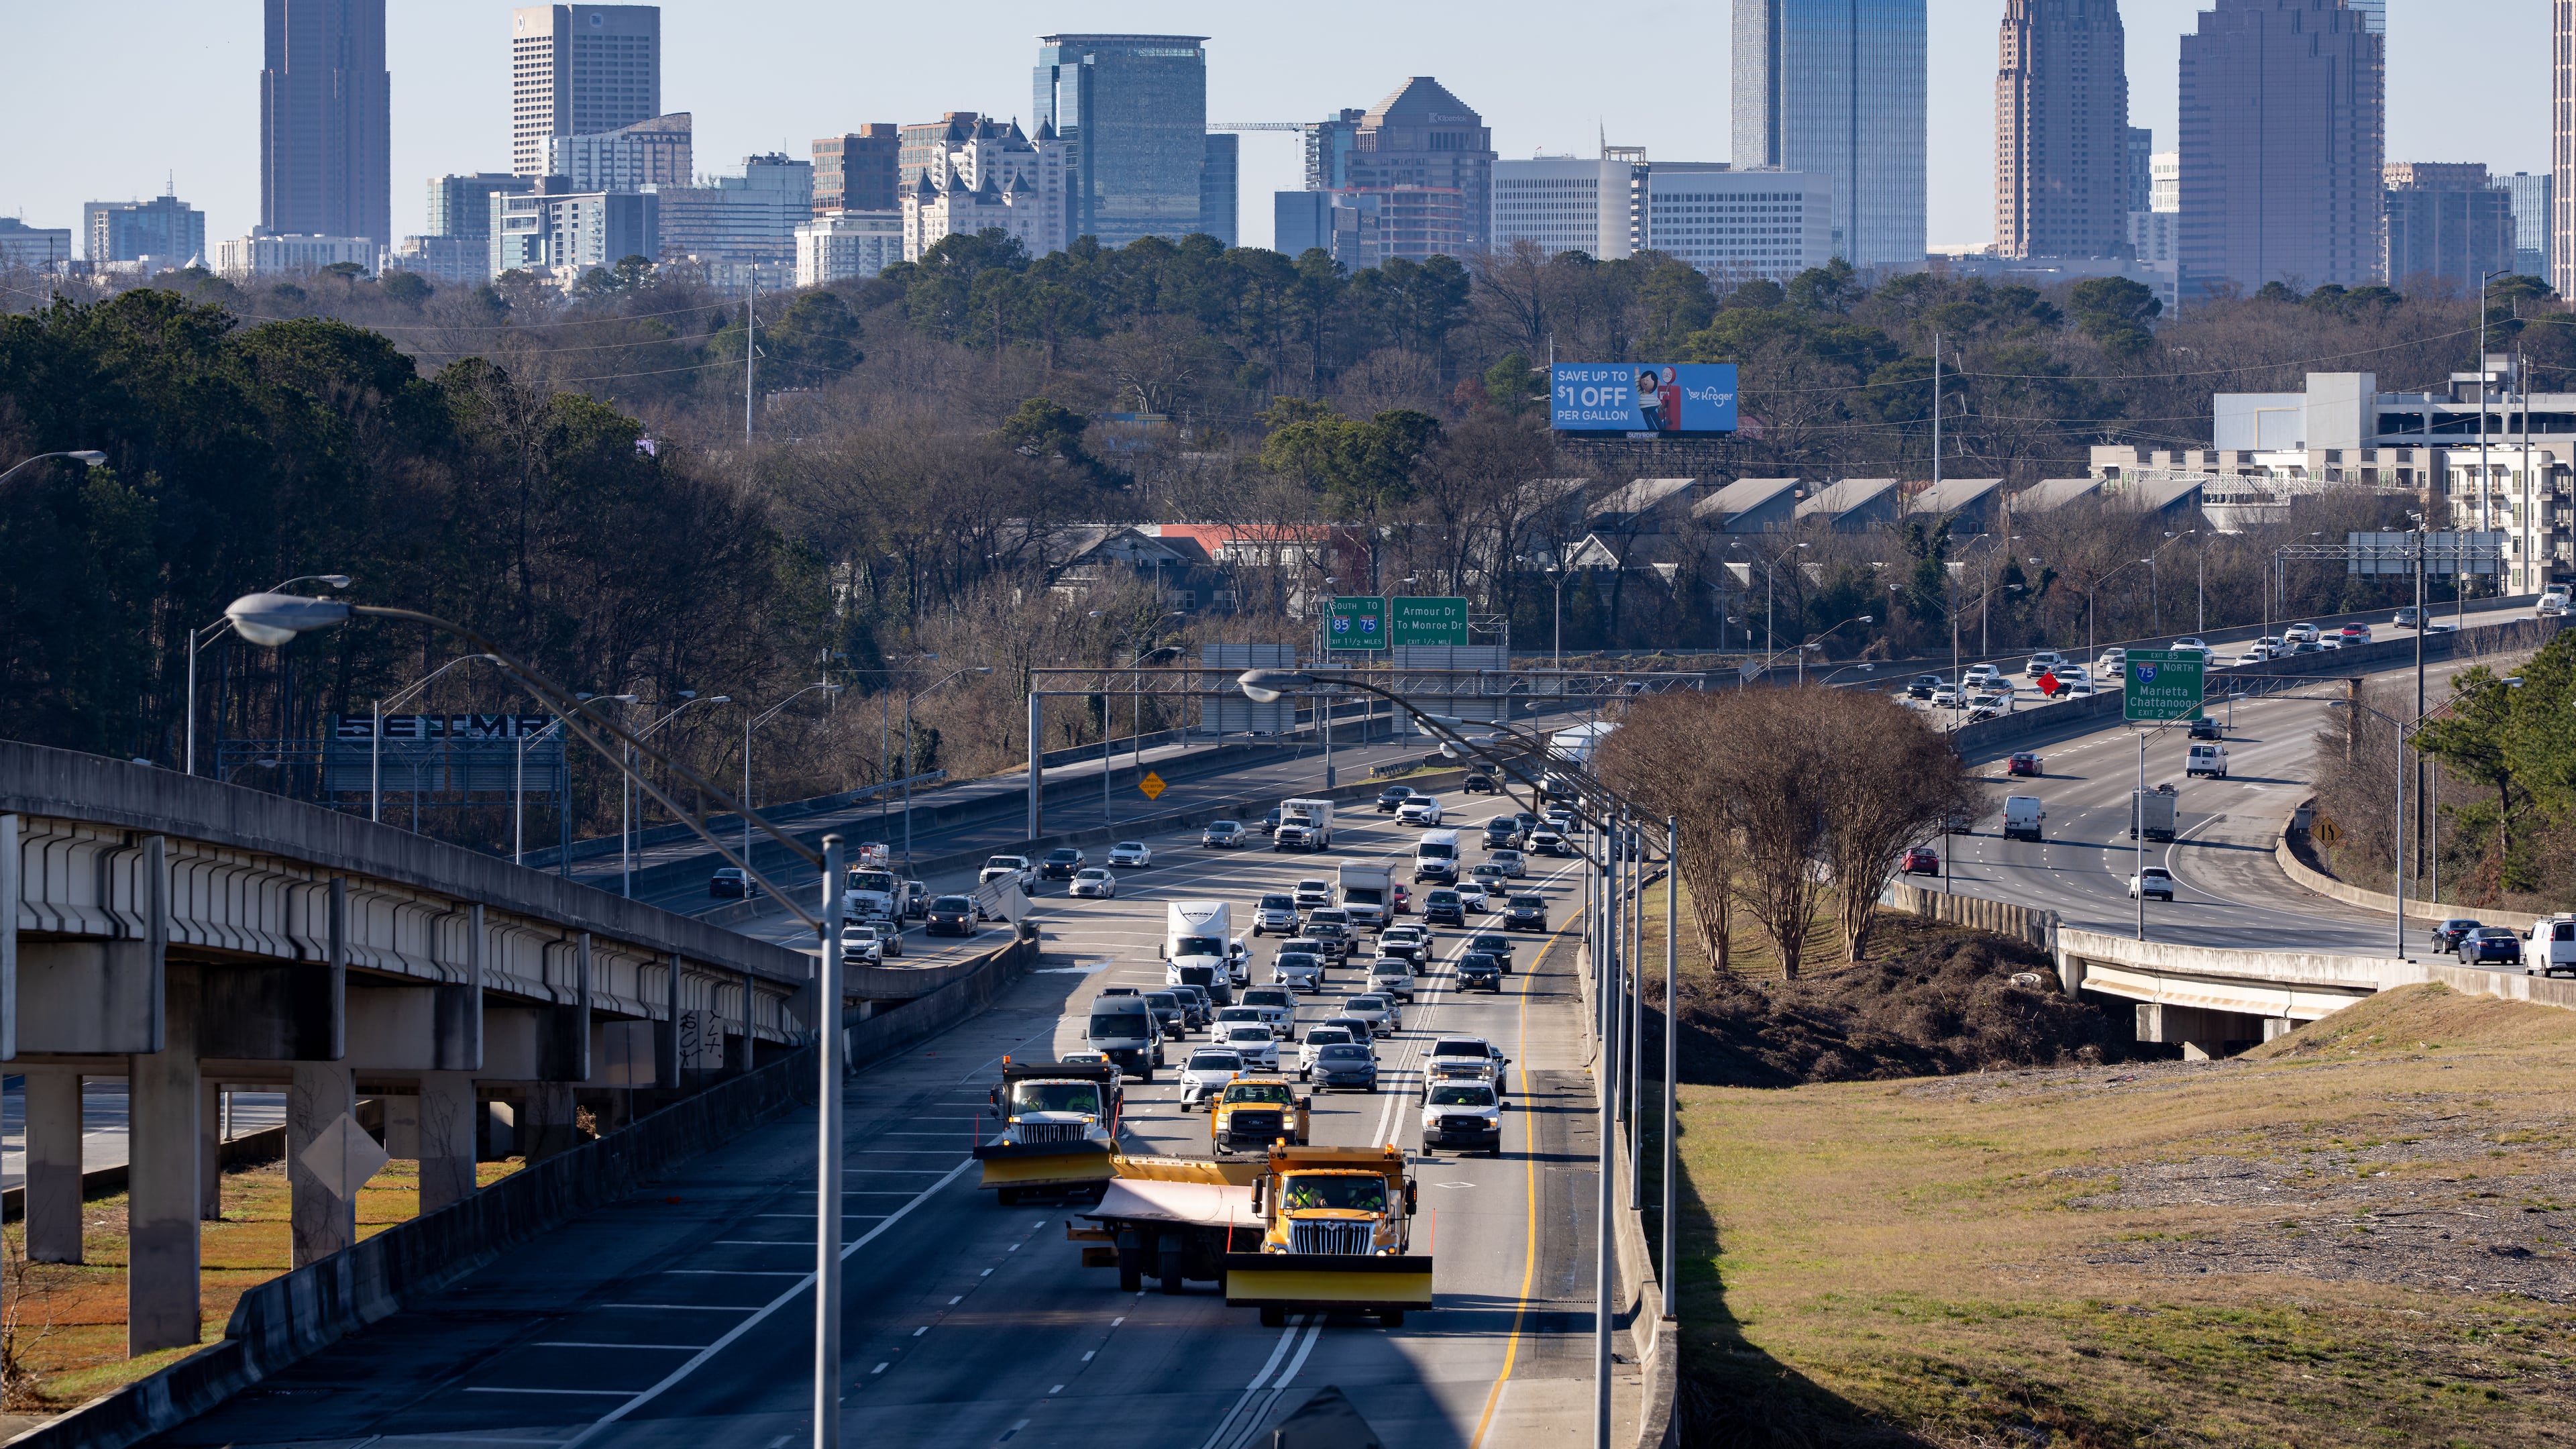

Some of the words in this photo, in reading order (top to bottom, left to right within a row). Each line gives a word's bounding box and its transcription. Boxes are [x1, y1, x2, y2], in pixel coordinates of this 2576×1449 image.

[1438, 115, 1466, 123] Kilpatrick
[1558, 370, 1589, 382] SAVE
[1592, 370, 1608, 382] UP
[1611, 370, 1628, 382] TO
[1557, 385, 1574, 407] $1
[1580, 386, 1628, 407] OFF
[1701, 386, 1733, 407] Kroger
[1558, 411, 1579, 421] PER
[1332, 602, 1357, 610] SOUTH
[1366, 602, 1378, 610] TO
[1403, 606, 1440, 616] Armour
[1444, 606, 1456, 616] Dr
[1334, 619, 1348, 630] 85
[1360, 619, 1375, 630] 75
[1397, 621, 1408, 630] To
[1412, 621, 1447, 630] Monroe
[1451, 621, 1462, 630] Dr
[2167, 652, 2179, 660] 85
[2163, 662, 2194, 672] NORTH
[2139, 667, 2154, 678] 75
[2140, 686, 2188, 696] Marietta
[2130, 696, 2198, 709] Chattanooga
[2157, 709, 2164, 718] 2
